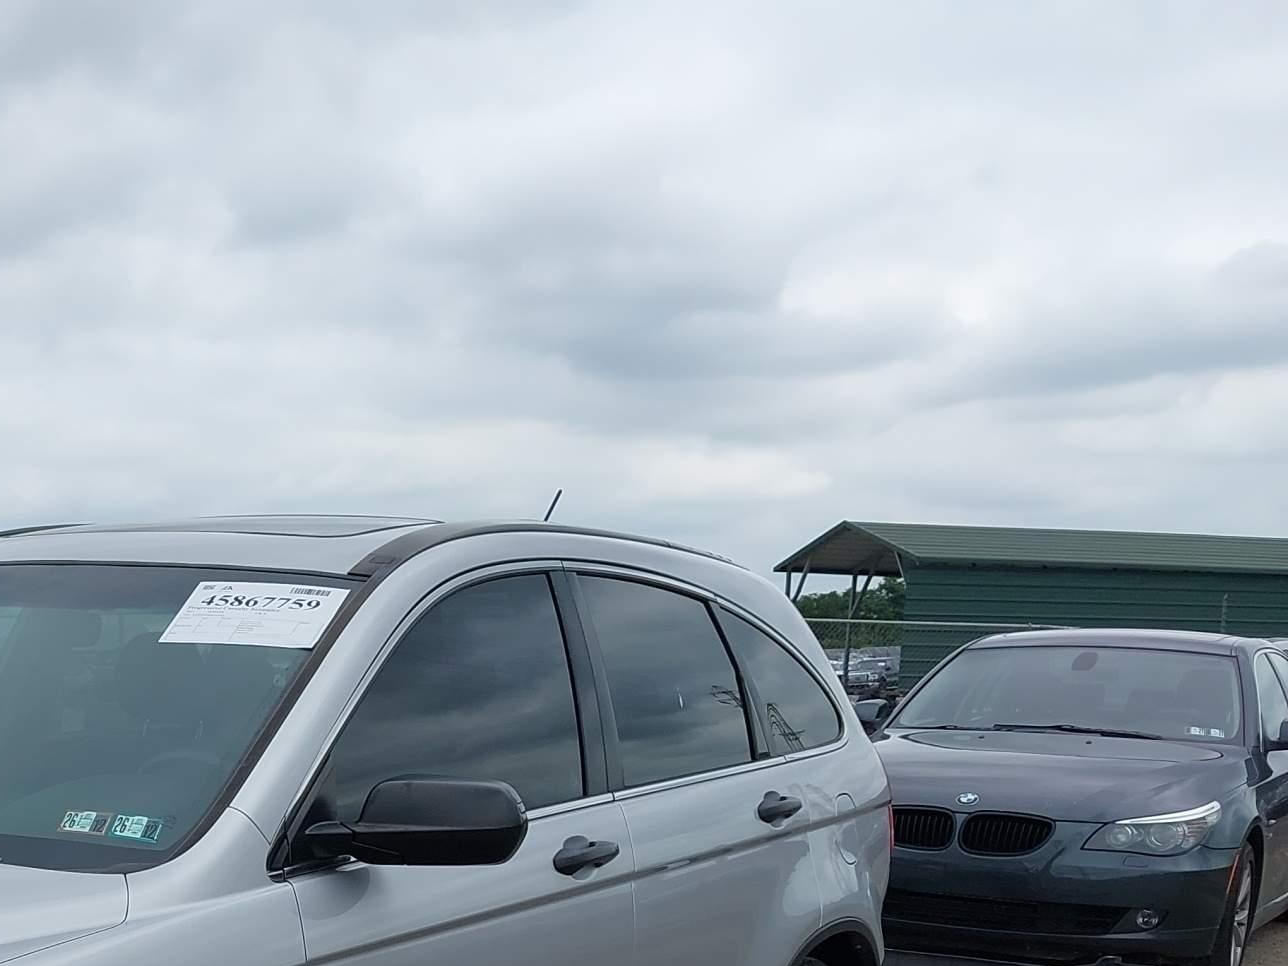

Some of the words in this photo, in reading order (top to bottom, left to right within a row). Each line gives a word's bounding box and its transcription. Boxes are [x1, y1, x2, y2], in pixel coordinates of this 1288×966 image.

[200, 594, 321, 611] 45867759
[63, 812, 79, 829] 26
[114, 816, 130, 833] 26
